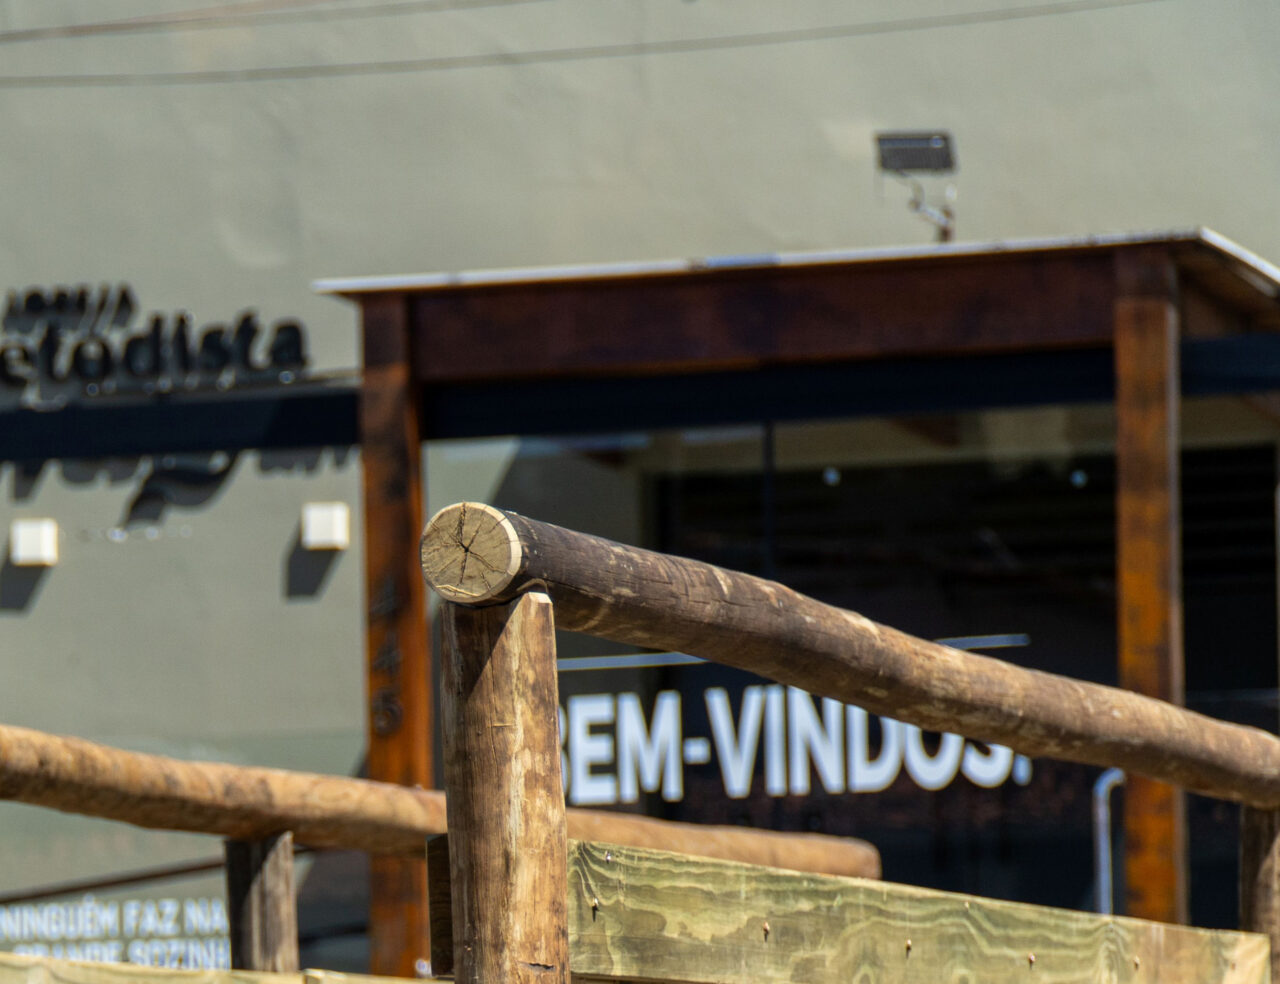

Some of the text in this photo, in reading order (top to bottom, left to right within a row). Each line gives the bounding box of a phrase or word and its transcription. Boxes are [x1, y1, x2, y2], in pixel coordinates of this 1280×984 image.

[558, 684, 1032, 805] EM-VINDO
[123, 899, 180, 937] FAZ
[183, 898, 230, 934] NA
[128, 936, 232, 970] SOZINH
